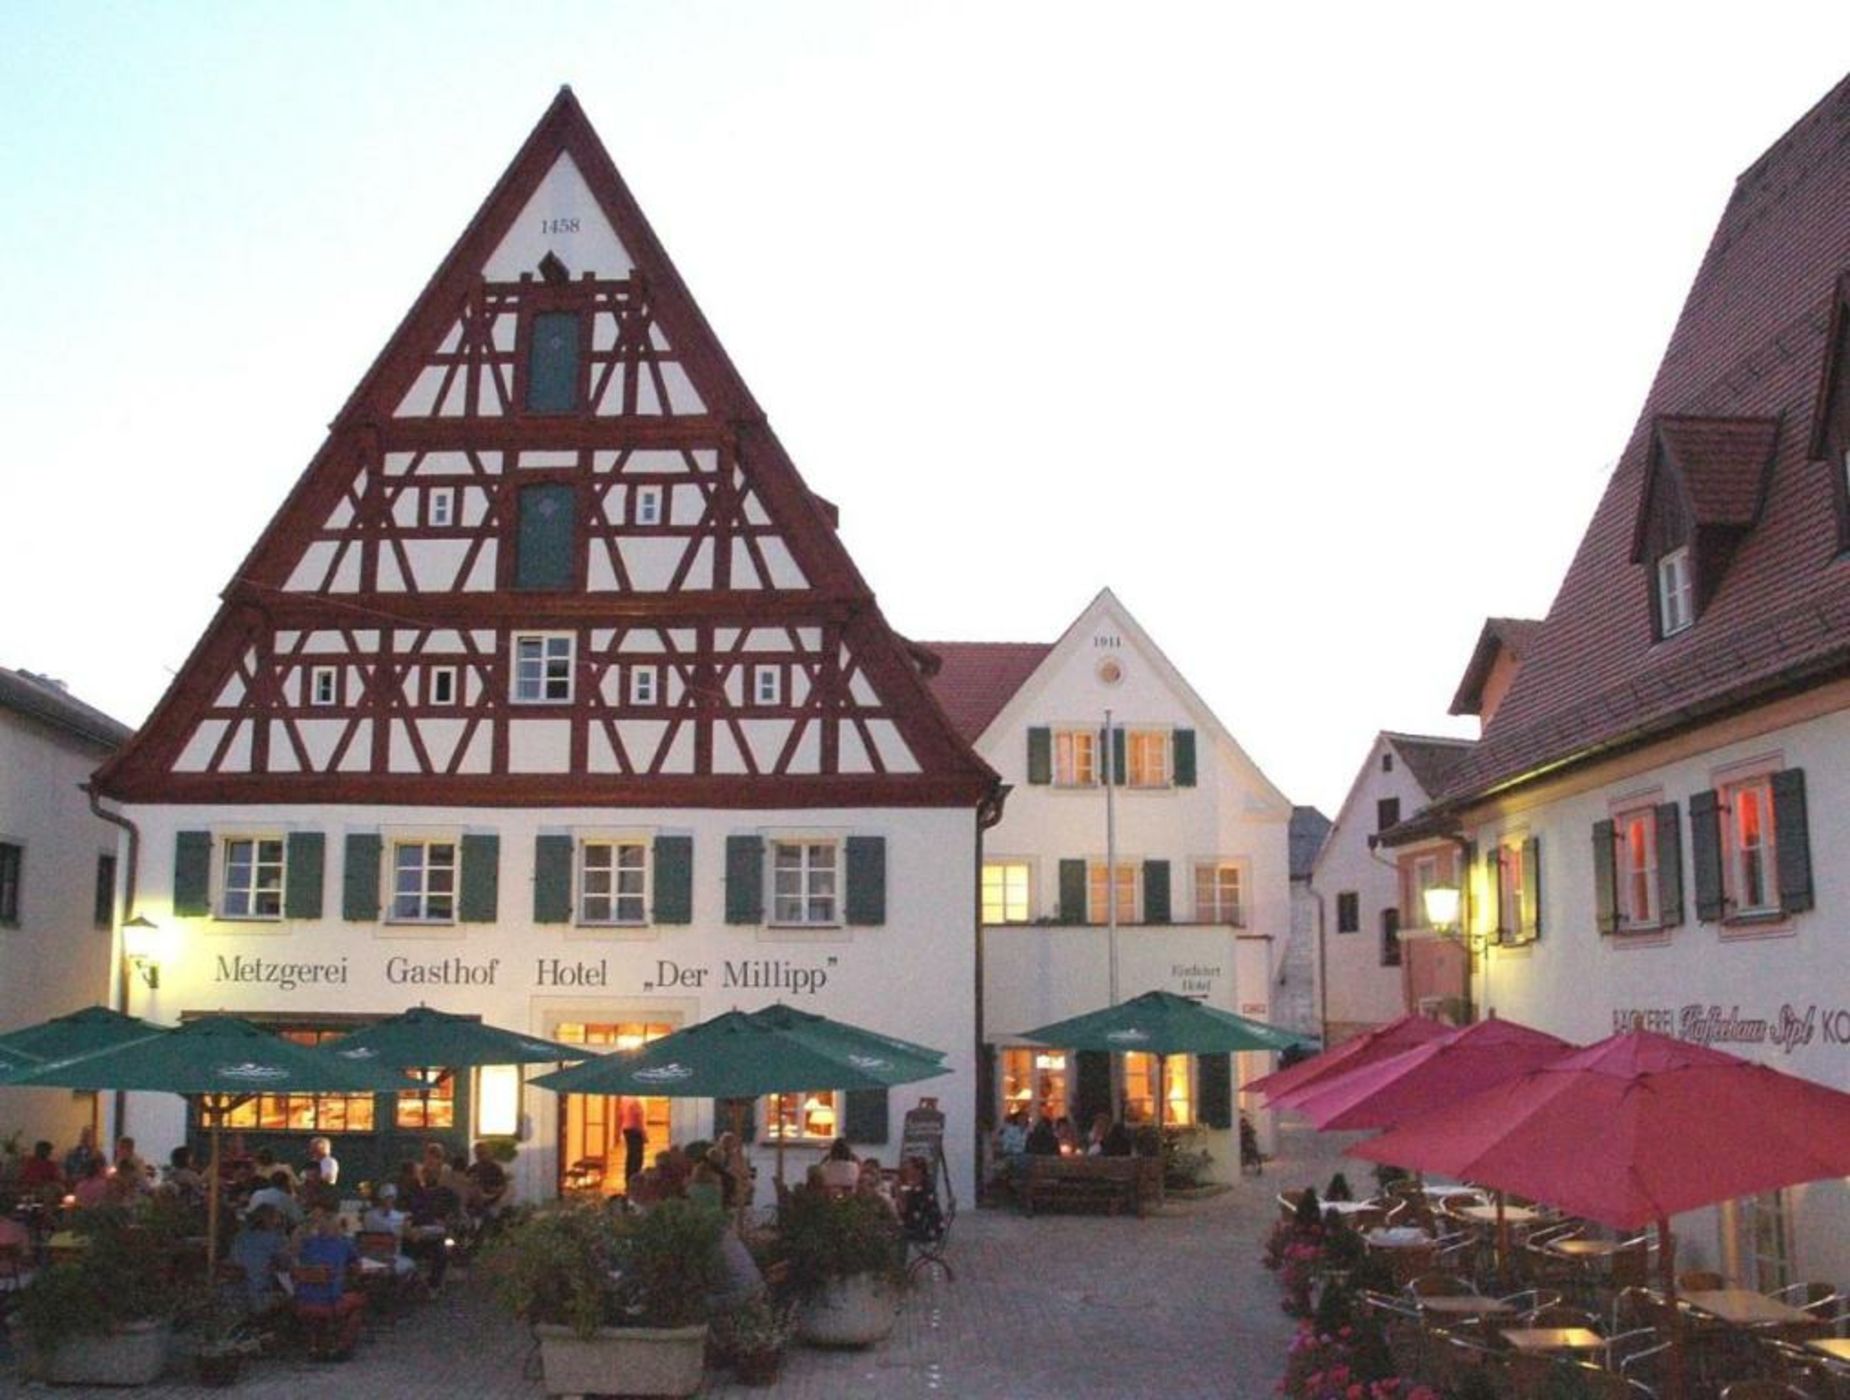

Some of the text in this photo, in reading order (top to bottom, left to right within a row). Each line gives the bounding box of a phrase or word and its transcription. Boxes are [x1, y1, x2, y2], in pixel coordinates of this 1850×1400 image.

[542, 218, 580, 234] 1458
[214, 954, 348, 991] Metzgerei
[386, 956, 499, 985] Gasthof
[536, 958, 607, 986] Hotel
